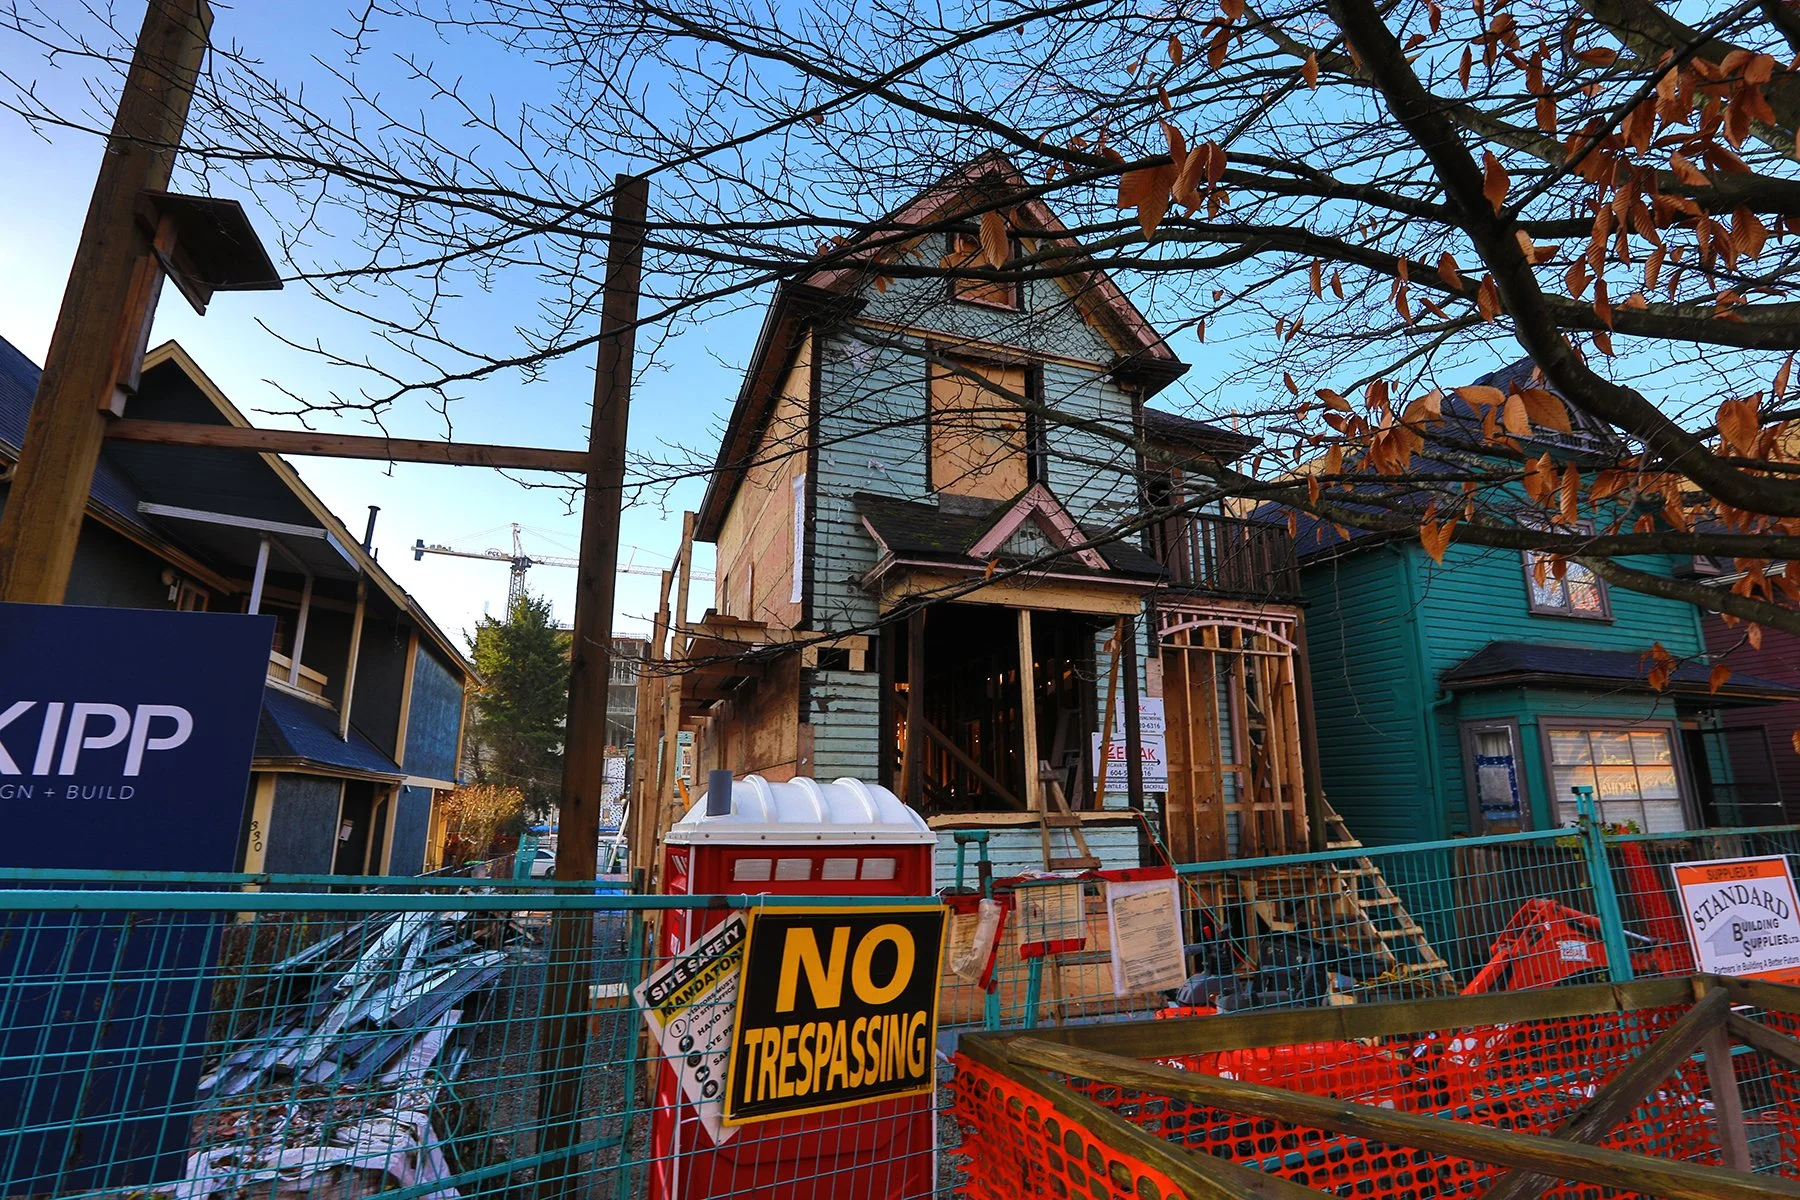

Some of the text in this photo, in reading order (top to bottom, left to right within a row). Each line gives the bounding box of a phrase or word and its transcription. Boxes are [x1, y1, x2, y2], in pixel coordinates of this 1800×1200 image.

[66, 785, 136, 800] BUILD
[1706, 865, 1759, 881] SUPPLIED BY
[1693, 884, 1789, 931] STANDARD
[1732, 918, 1780, 942] BUILDING
[1743, 934, 1788, 958] SUPPLIES
[651, 925, 740, 1001] SITE SAFETY
[775, 923, 916, 1013] NO
[743, 1010, 927, 1103] TRESPASSING
